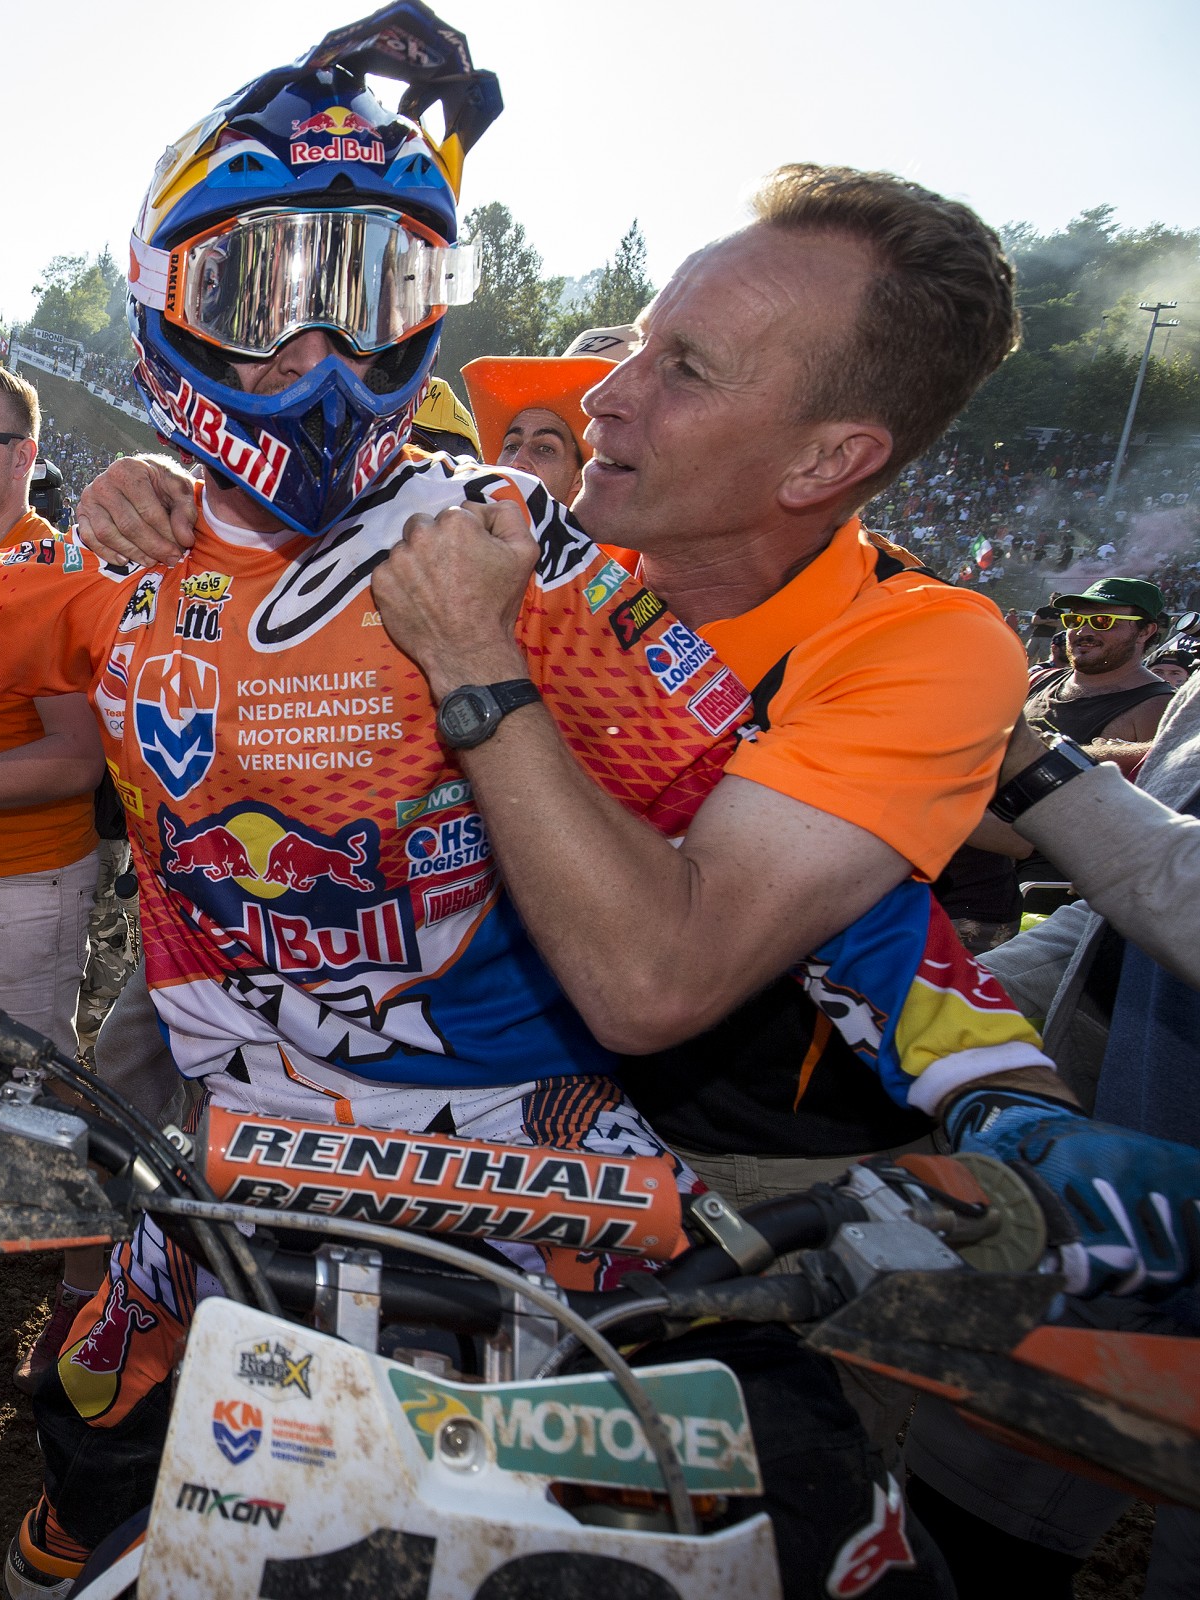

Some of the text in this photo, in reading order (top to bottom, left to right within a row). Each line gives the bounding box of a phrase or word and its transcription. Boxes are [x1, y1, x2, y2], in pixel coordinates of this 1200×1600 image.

[290, 137, 385, 165] Red Bull
[165, 253, 177, 313] OAKLEY
[41, 330, 64, 344] IPONE
[190, 396, 291, 502] Bull
[237, 670, 377, 697] KONINKLIJKE
[238, 697, 394, 722] NEDERLANDSE
[238, 722, 404, 747] MOTORRIJDERS
[237, 750, 374, 772] VERENIGING
[409, 841, 492, 879] LOGISTIC
[270, 897, 408, 971] Bull
[225, 1121, 654, 1209] RENTHAL
